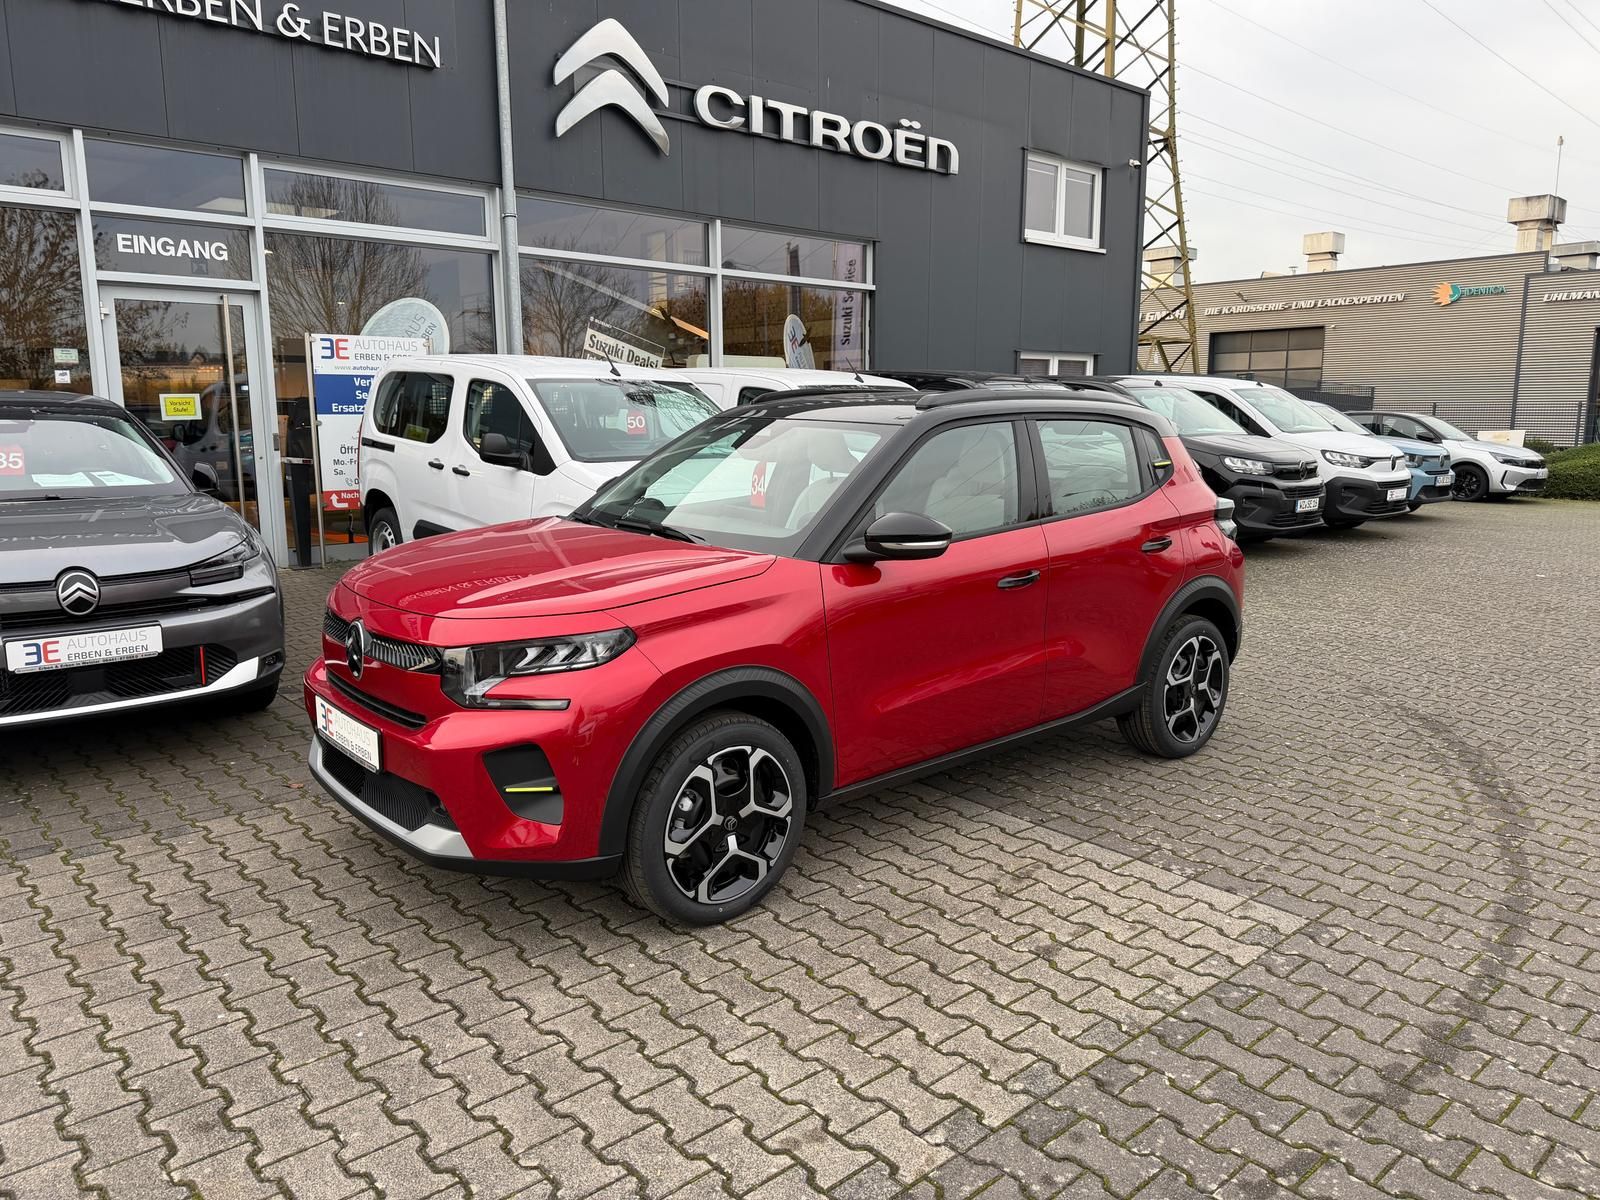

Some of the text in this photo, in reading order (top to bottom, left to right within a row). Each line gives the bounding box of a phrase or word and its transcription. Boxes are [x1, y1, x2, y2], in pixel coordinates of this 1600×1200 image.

[276, 3, 311, 41] &
[322, 11, 441, 68] ERBEN
[116, 233, 229, 261] EINGANG
[1204, 306, 1220, 316] DIE
[1292, 299, 1314, 310] UND
[1317, 293, 1406, 308] LACKEXPERTEN
[841, 305, 856, 346] Suzuki
[354, 339, 418, 352] AUTOHAUS
[588, 334, 625, 361] Suzuki
[354, 352, 382, 361] ERBEN
[331, 403, 364, 413] Ersatz
[627, 415, 646, 429] 50
[751, 474, 766, 496] 34
[66, 629, 148, 650] AUTOHAUS
[67, 650, 102, 661] ERBEN
[105, 648, 112, 657] &
[115, 643, 149, 655] ERBEN
